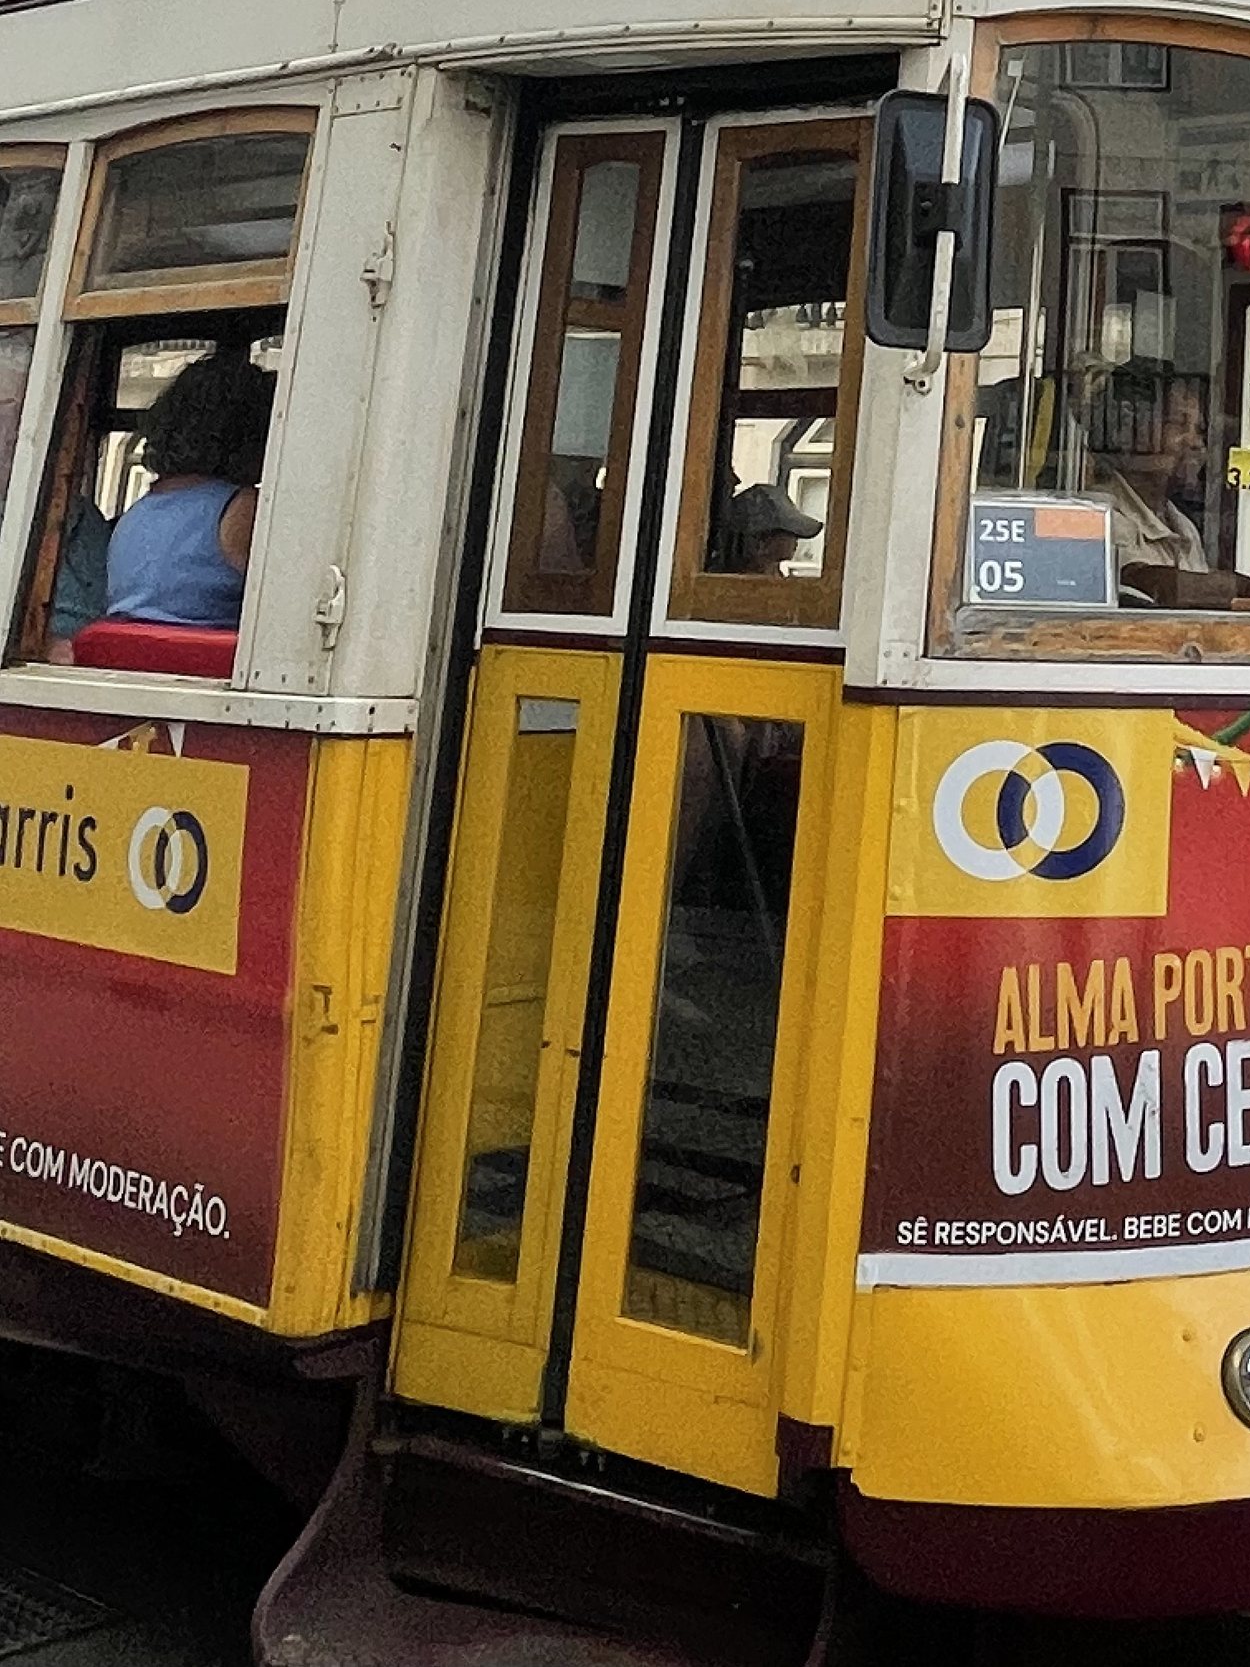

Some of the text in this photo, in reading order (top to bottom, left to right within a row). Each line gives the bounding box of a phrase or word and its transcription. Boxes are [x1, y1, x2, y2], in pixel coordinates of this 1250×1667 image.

[978, 518, 1026, 543] 25E
[978, 559, 1026, 594] 05
[992, 955, 1140, 1055] ALMA
[991, 1049, 1162, 1196] COM
[9, 1136, 66, 1185] COM
[67, 1152, 231, 1240] MODERAÇÃO.
[897, 1216, 928, 1246] SÊ
[934, 1215, 1118, 1246] RESPONSÁVEL.
[1123, 1212, 1182, 1241] BEBE
[1186, 1208, 1242, 1235] COM
